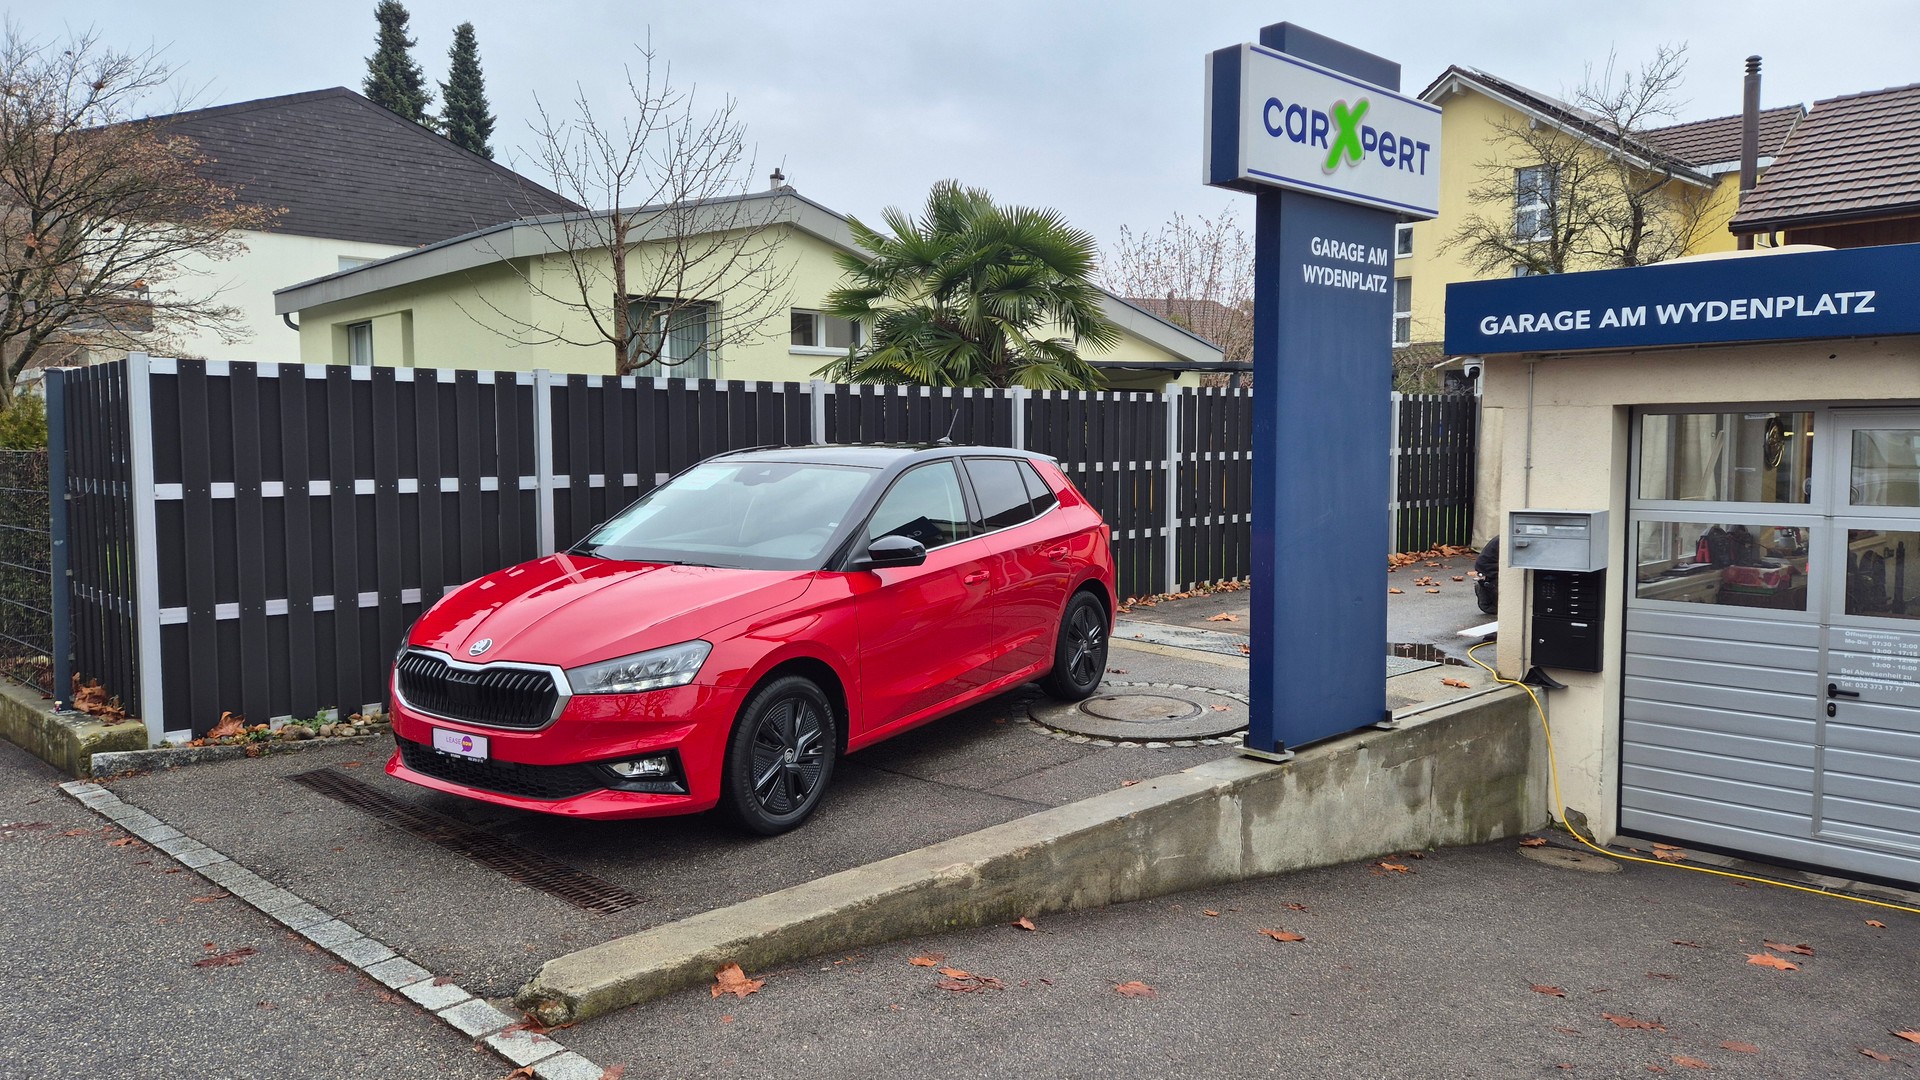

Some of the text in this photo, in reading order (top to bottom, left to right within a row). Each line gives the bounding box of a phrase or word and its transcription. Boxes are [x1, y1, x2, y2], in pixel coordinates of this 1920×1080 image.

[1311, 236, 1388, 267] GARAGE AM
[1303, 264, 1387, 293] WYDENPLATZ
[1479, 290, 1876, 336] GARAGE AM WYDENPLATZ
[1854, 669, 1901, 680] Abwesenheit
[445, 736, 461, 745] LEASE
